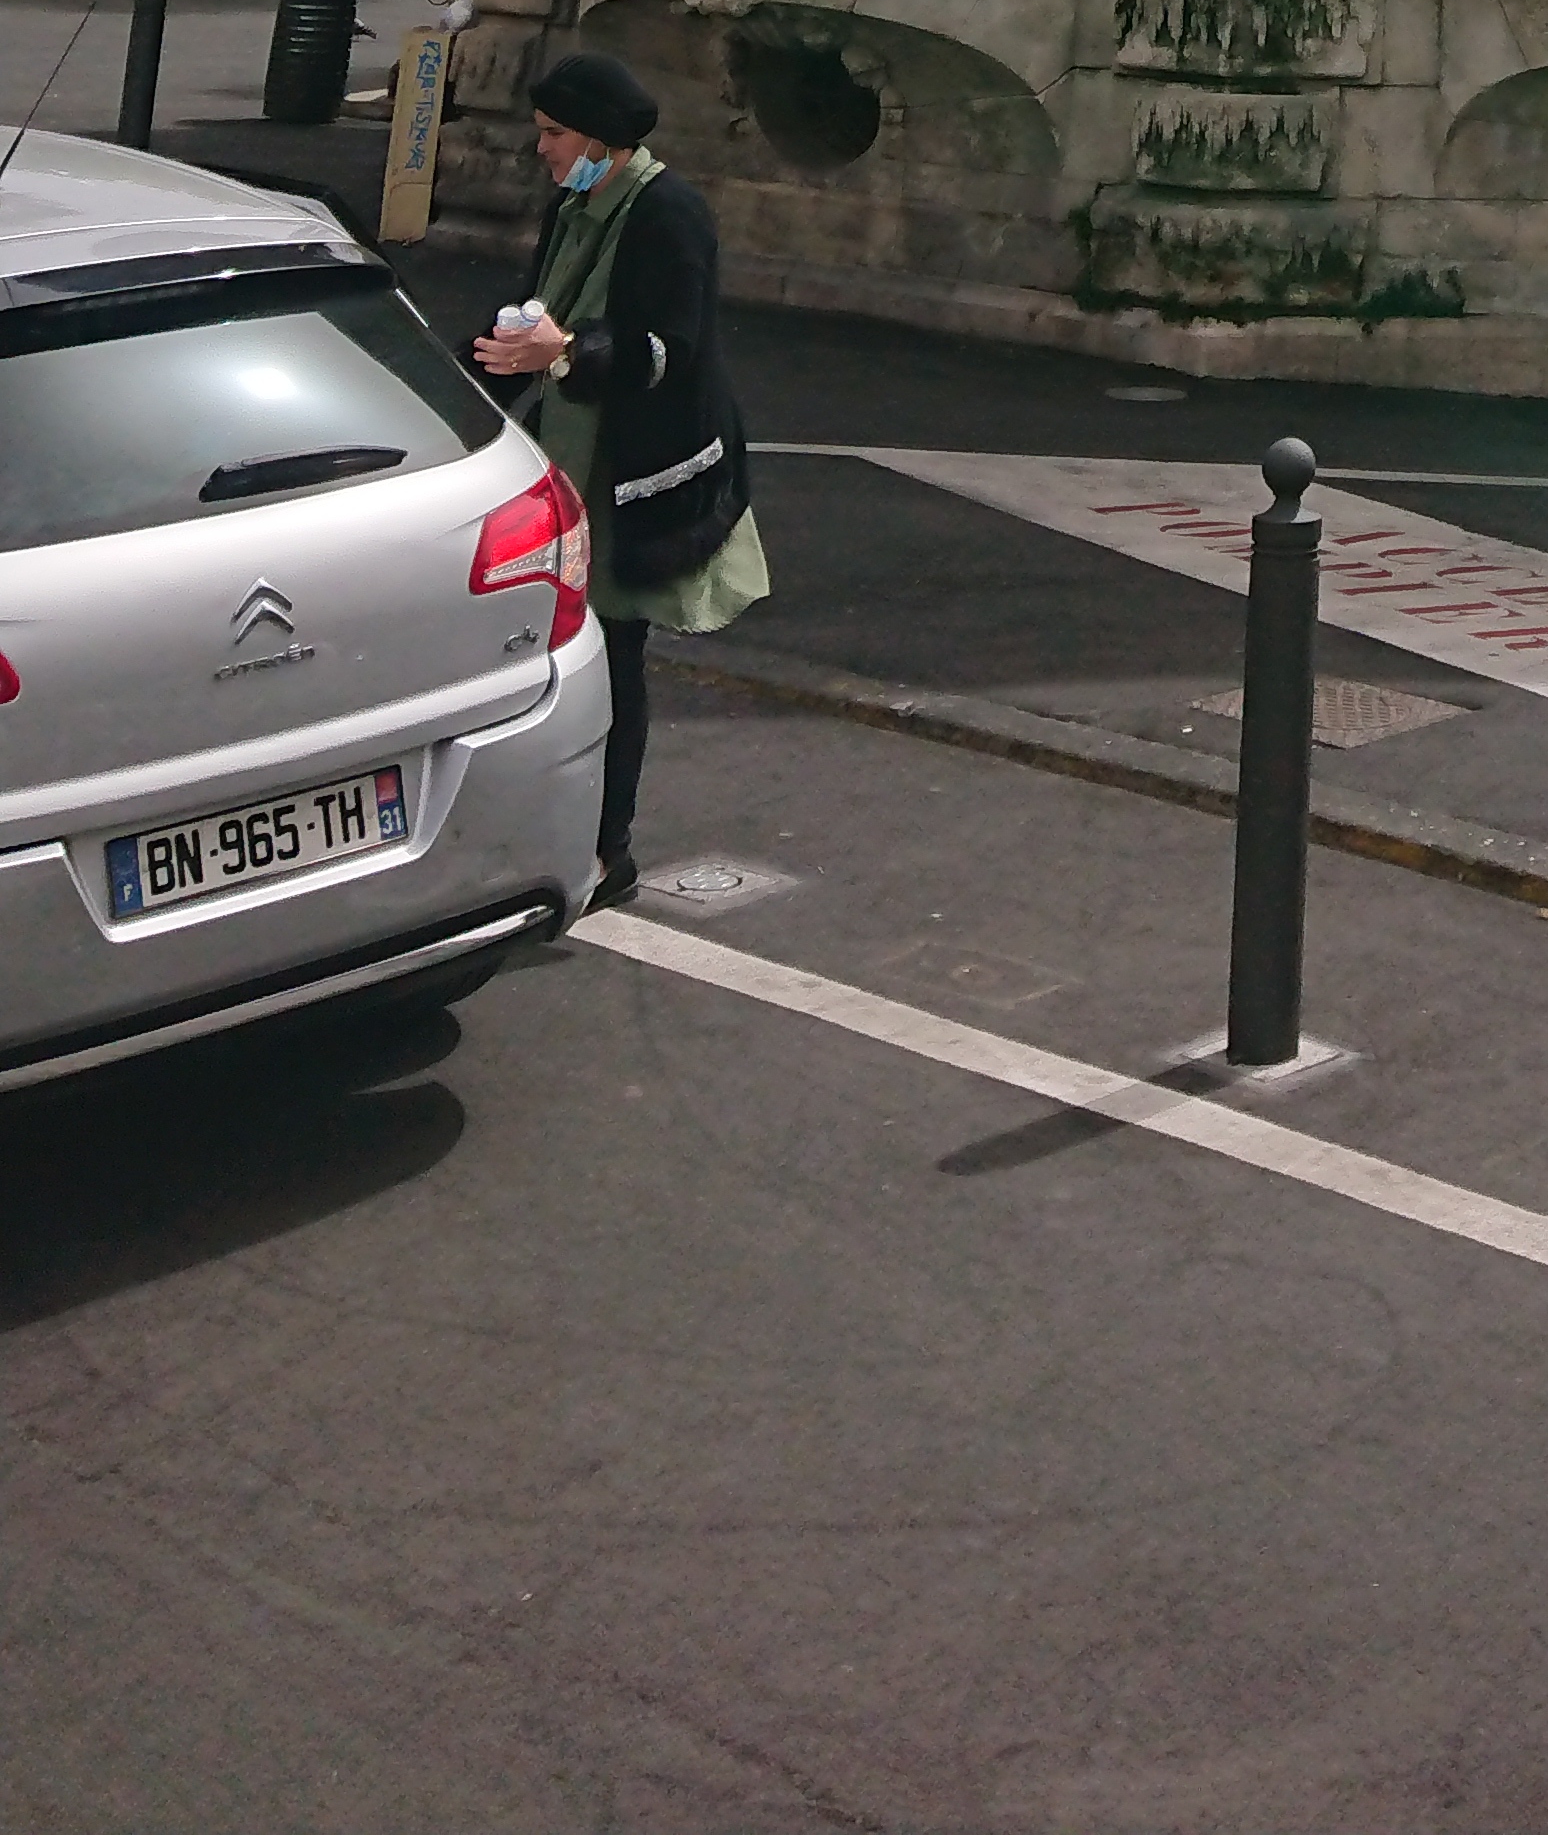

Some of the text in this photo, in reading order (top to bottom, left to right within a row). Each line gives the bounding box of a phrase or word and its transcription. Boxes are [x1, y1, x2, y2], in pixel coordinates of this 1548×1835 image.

[380, 804, 404, 835] 31
[147, 786, 366, 896] BN-965-TH
[122, 883, 134, 902] F
